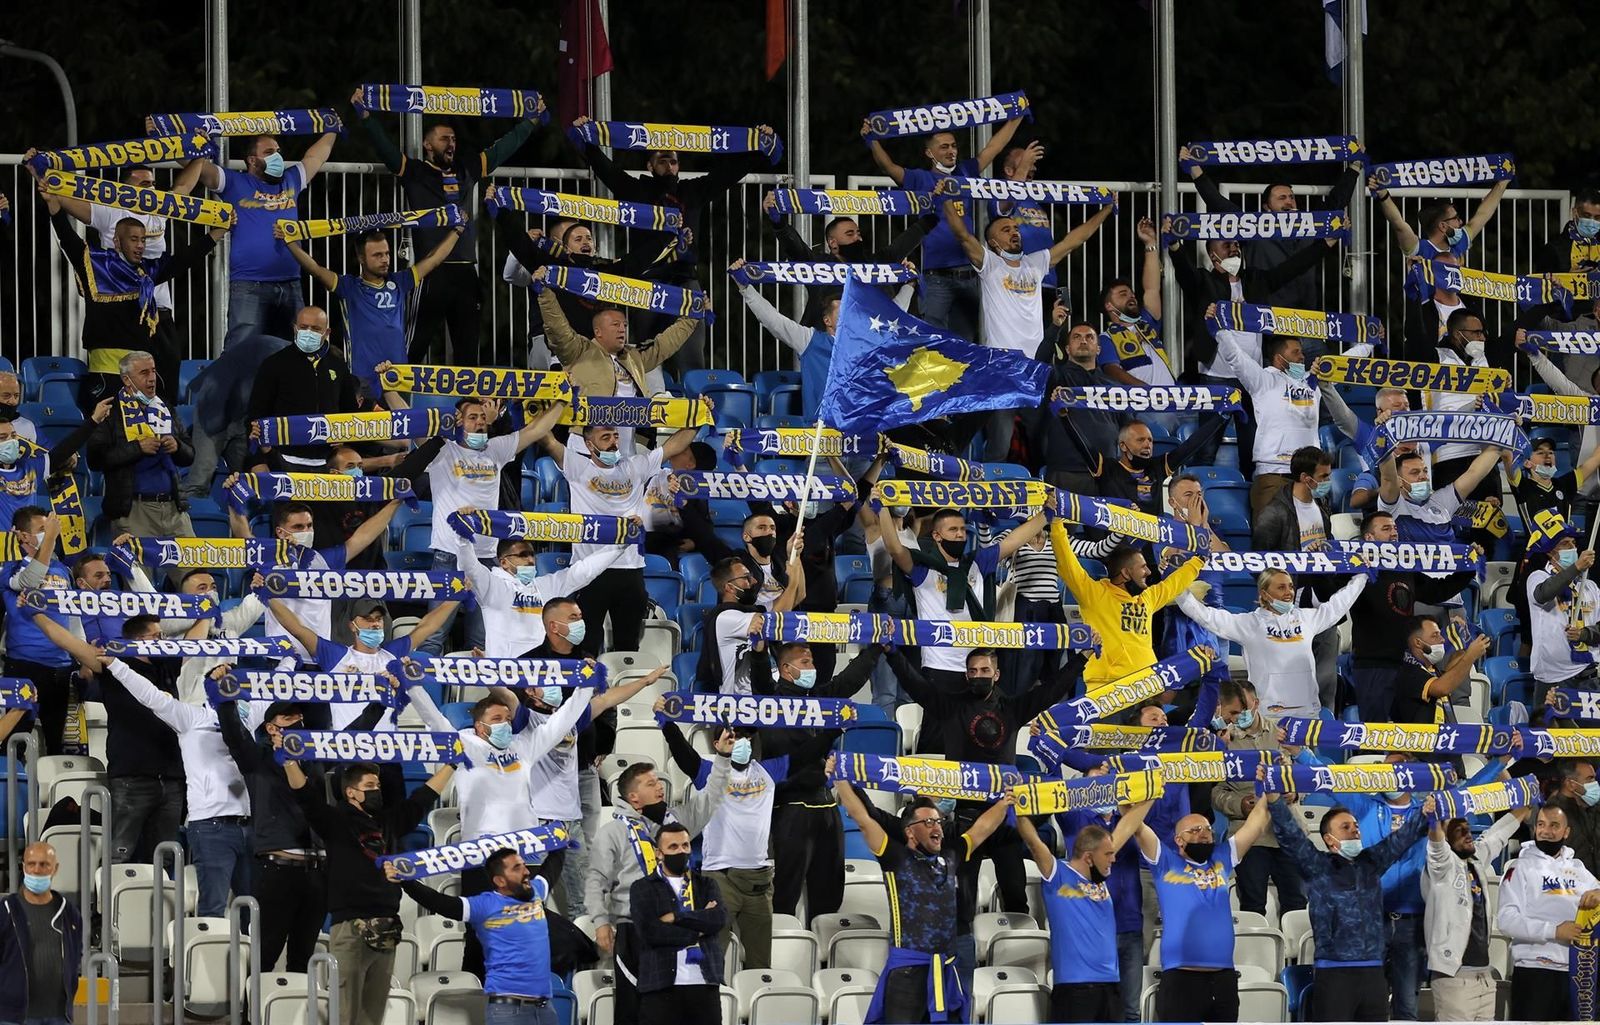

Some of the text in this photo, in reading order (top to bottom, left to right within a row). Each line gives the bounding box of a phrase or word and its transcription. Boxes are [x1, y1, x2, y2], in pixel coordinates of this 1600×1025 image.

[406, 87, 497, 115] Dardanët
[196, 112, 297, 136] Dardanët
[893, 97, 1008, 134] KOSOVA
[625, 123, 730, 153] Dardanët
[1214, 138, 1336, 163] KOSOVA
[63, 137, 182, 169] KOSOVA
[1395, 157, 1494, 186] KOSOVA
[815, 190, 895, 213] Dardanët
[966, 177, 1089, 202] KOSOVA
[541, 191, 637, 225] Dardanët
[1198, 212, 1317, 238] KOSOVA
[768, 263, 898, 284] KOSOVA
[1444, 264, 1531, 301] Dardanët
[374, 291, 395, 308] 22
[581, 272, 668, 311] Dardanët
[1257, 307, 1343, 338] Dardanët
[1084, 386, 1215, 410] KOSOVA
[306, 412, 411, 441] Dardanët
[1447, 415, 1517, 446] KOSOVA
[274, 473, 373, 500] Dardanët
[707, 472, 833, 500] KOSOVA
[509, 511, 601, 542] Dardanët
[1094, 501, 1174, 546] Dardanët
[157, 538, 265, 568] Dardanët
[1203, 551, 1337, 573] KOSOVA
[298, 571, 434, 598] KOSOVA
[54, 590, 186, 616] KOSOVA
[795, 614, 862, 642] Dardanët
[931, 621, 1046, 650] Dardanët
[137, 637, 269, 656] KOSOVA
[432, 658, 568, 685] KOSOVA
[248, 672, 382, 700] KOSOVA
[1069, 663, 1183, 725] Dardanët
[693, 694, 826, 727] KOSOVA
[311, 732, 443, 760] KOSOVA
[1340, 723, 1459, 751] Dardanët
[879, 757, 980, 790] Dardanët
[1139, 752, 1245, 781] Dardanët
[1312, 765, 1416, 793] Dardanët
[1461, 784, 1519, 815] Dardanët
[416, 832, 546, 875] KOSOVA
